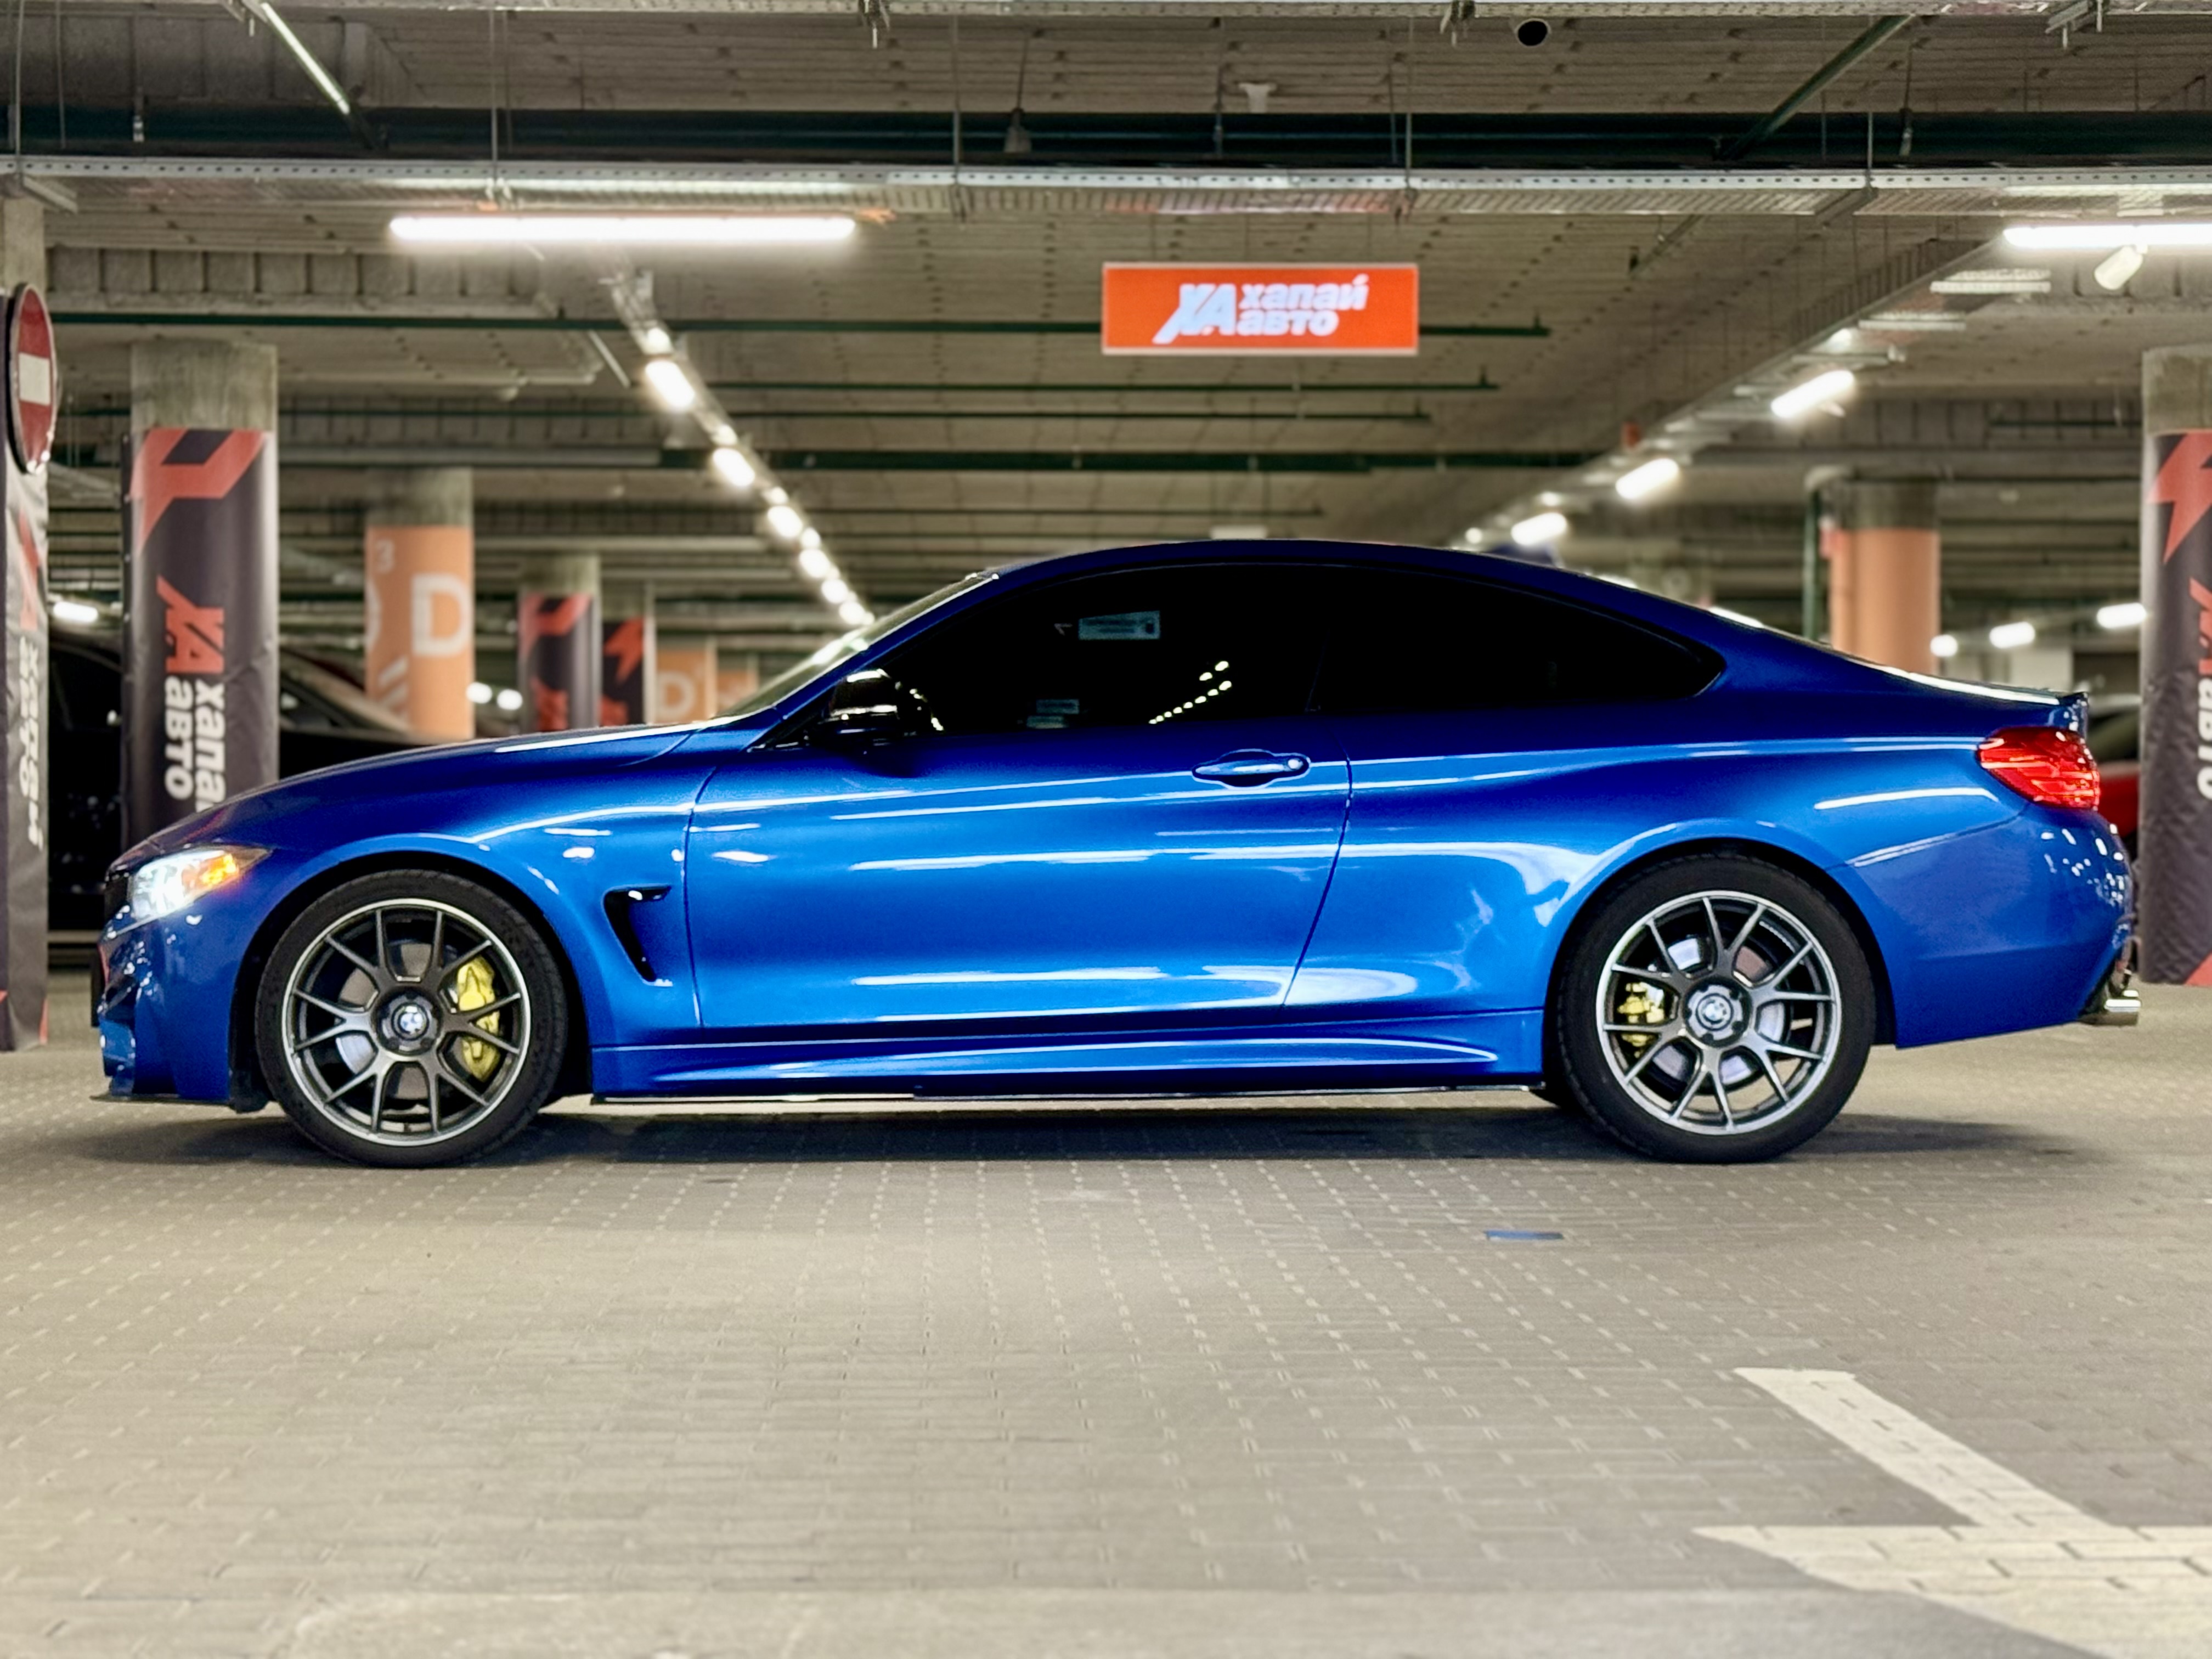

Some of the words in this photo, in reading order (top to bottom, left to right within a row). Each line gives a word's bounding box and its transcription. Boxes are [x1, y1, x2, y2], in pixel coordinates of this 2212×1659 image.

[1236, 309, 1339, 336] авто
[1238, 273, 1369, 311] хапай
[410, 573, 473, 656] D
[165, 675, 194, 800] авто
[194, 678, 226, 813] хапа
